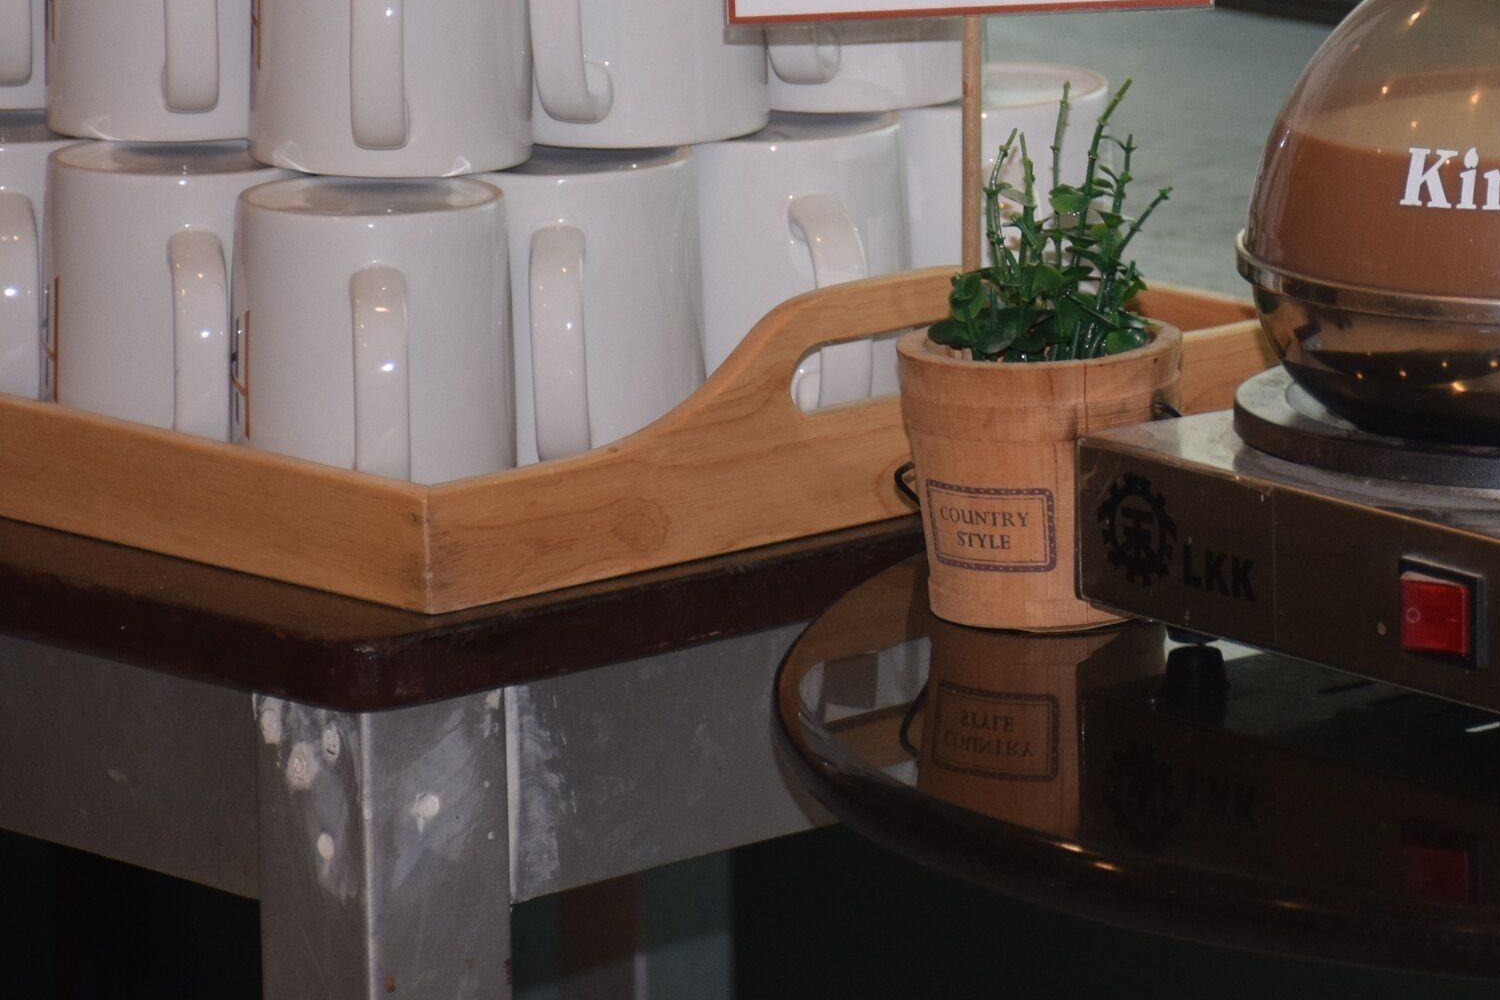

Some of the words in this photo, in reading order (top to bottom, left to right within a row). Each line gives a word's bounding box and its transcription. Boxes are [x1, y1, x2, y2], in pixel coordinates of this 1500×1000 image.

[940, 505, 1030, 528] COUNTRY
[956, 531, 1011, 551] STYLE
[1184, 543, 1257, 602] LKK
